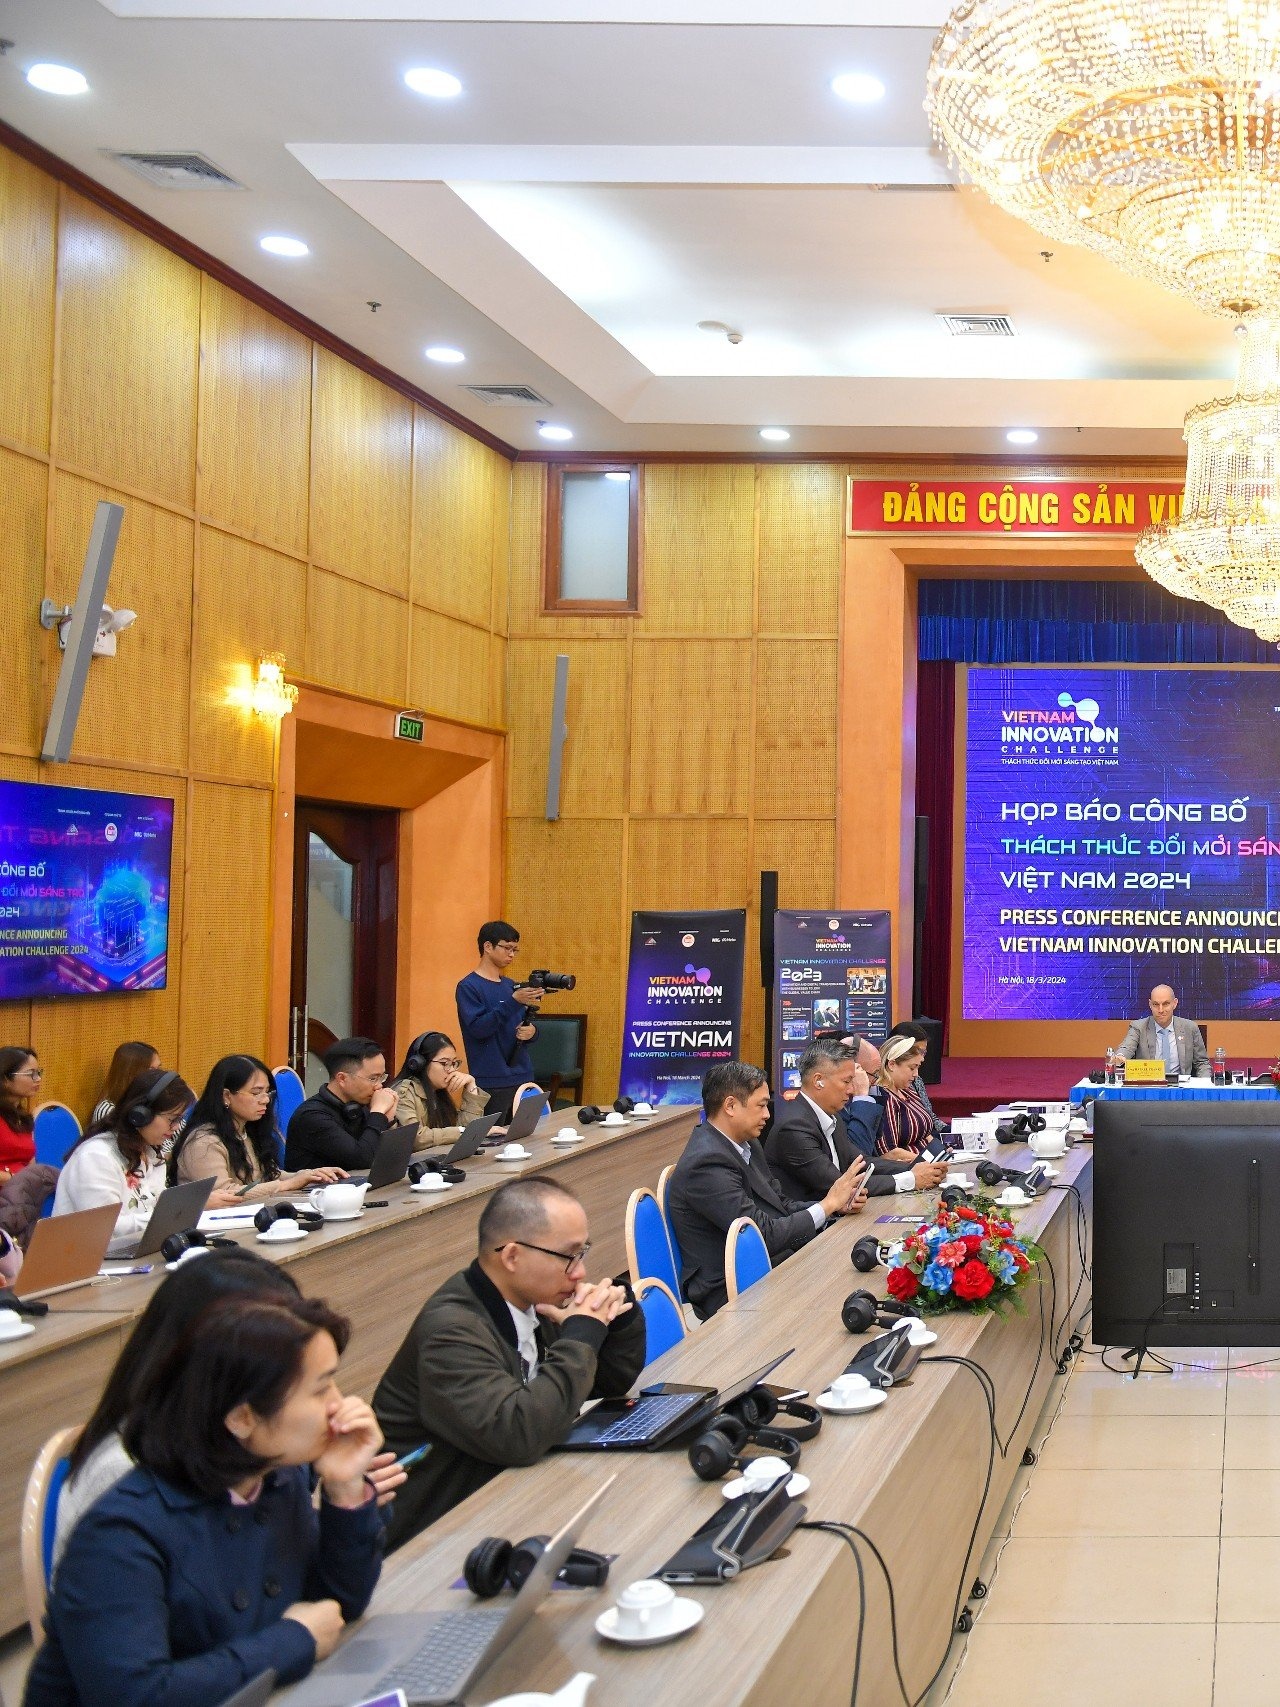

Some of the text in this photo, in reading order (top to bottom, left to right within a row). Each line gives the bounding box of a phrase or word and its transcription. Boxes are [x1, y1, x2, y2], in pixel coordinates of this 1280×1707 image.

[882, 483, 1187, 531] ĐẢNG CỘNG SẢN VI
[1001, 710, 1076, 724] VIETNAM
[401, 719, 420, 738] EXIT
[1001, 726, 1119, 743] INNOVATION
[1001, 746, 1119, 754] CHALLENGE
[1001, 796, 1250, 826] HỌP BÁO CÔNG BỐ
[1000, 834, 1076, 855] THÁCH
[1081, 832, 1141, 855] THỨC
[1146, 832, 1186, 855] ĐỔI
[28, 861, 46, 877] BỐ
[1000, 866, 1191, 894] VIỆT NAM 2024
[0, 906, 20, 918] 024
[1000, 909, 1058, 925] PRESS
[1062, 910, 1182, 926] CONFERENCE
[16, 930, 68, 940] ANNOUNCING
[26, 946, 68, 956] CHALLENGE
[70, 945, 89, 954] 2024
[1000, 937, 1084, 953] VIETNAM
[1088, 937, 1204, 954] INNOVATION
[650, 976, 696, 985] VIETNAM
[781, 968, 822, 982] 2023
[998, 976, 1009, 984] Hà
[1026, 976, 1066, 984] 18/3/2024
[648, 986, 722, 998] INNOVATION
[630, 1030, 733, 1048] VIETNAM
